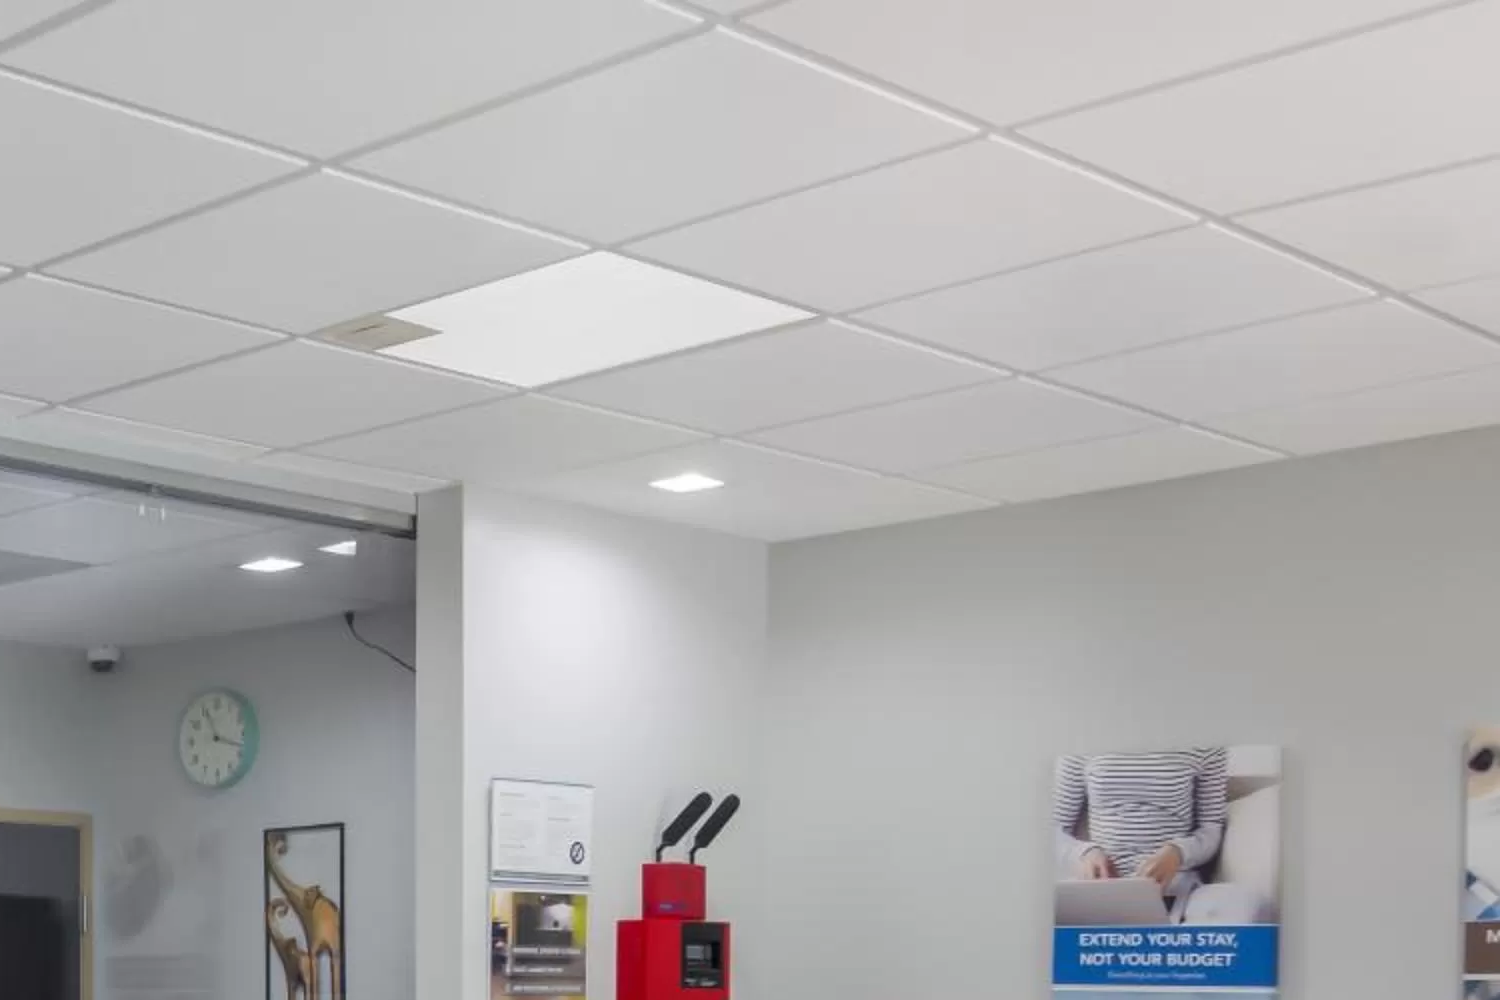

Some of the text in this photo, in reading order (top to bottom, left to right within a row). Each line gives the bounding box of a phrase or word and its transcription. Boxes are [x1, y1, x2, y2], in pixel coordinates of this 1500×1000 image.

[1079, 933, 1239, 948] EXTEND YOUR STAY,
[1080, 953, 1113, 967] NOT
[1119, 953, 1163, 967] YOUR
